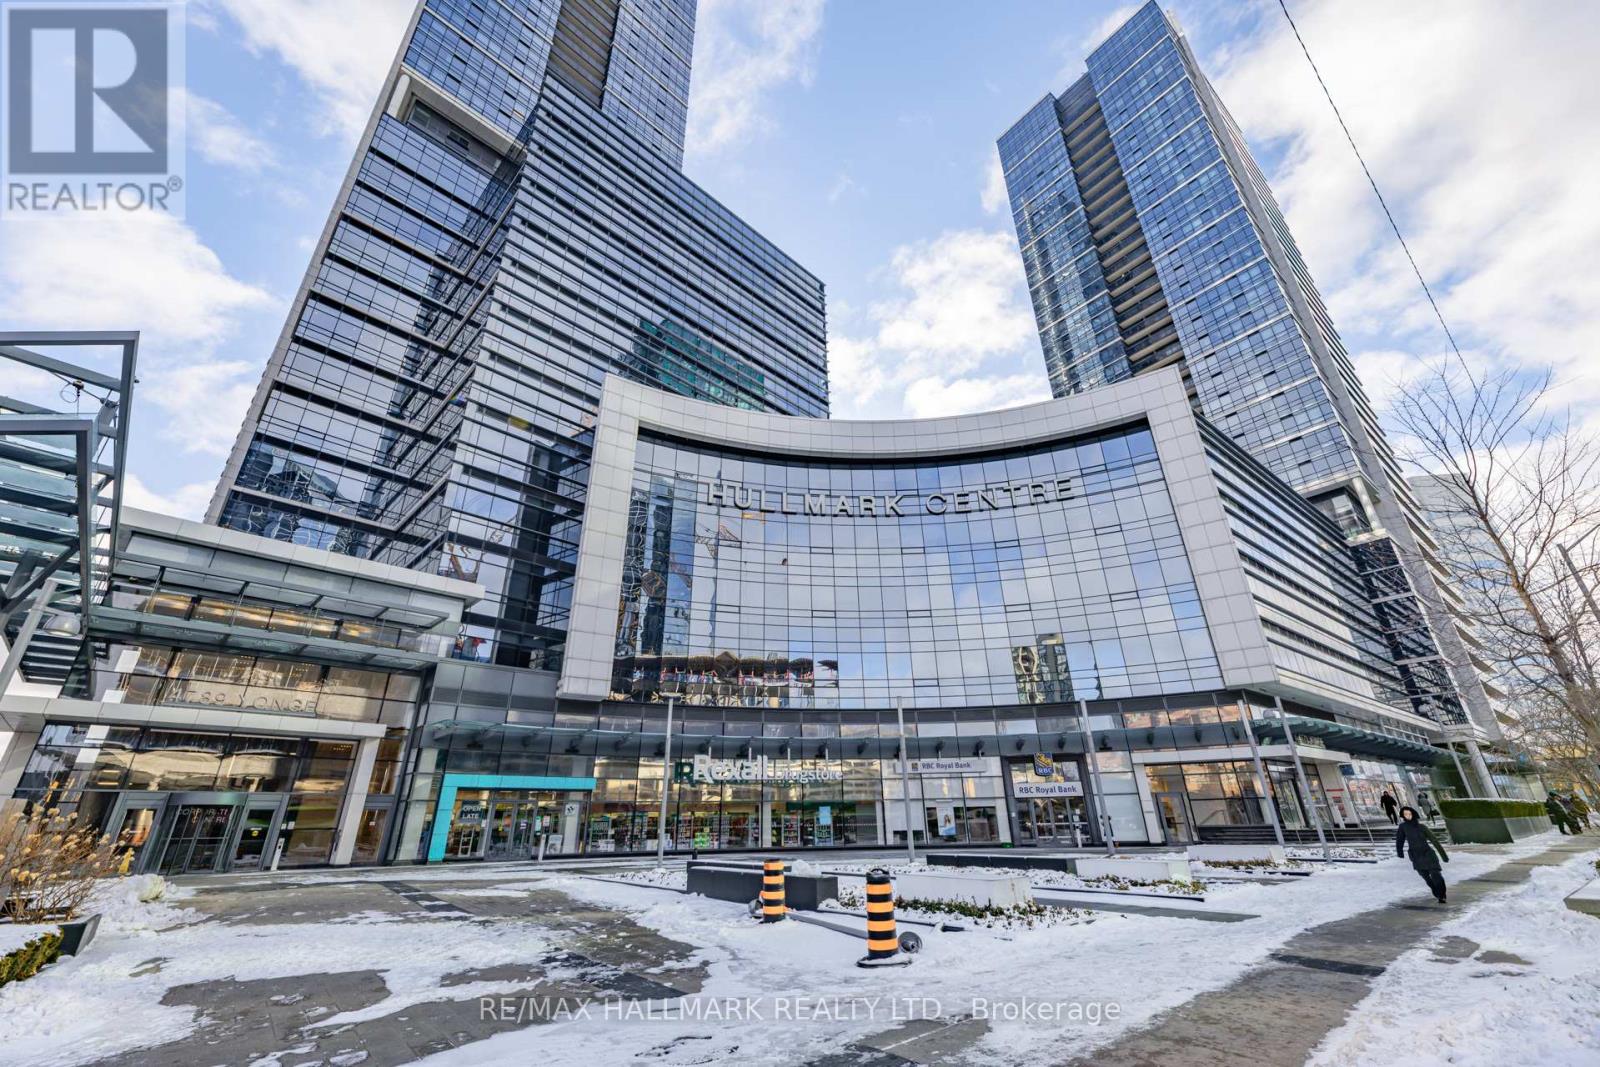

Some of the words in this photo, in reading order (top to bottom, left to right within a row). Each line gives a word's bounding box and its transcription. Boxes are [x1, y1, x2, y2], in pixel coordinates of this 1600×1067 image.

[707, 482, 904, 517] HULLMARK
[926, 479, 1075, 515] CENTRE
[694, 754, 769, 784] Rexall
[936, 762, 954, 770] Royal
[1019, 786, 1034, 794] RBC
[1035, 786, 1056, 795] Royal
[1057, 785, 1077, 793] Bank
